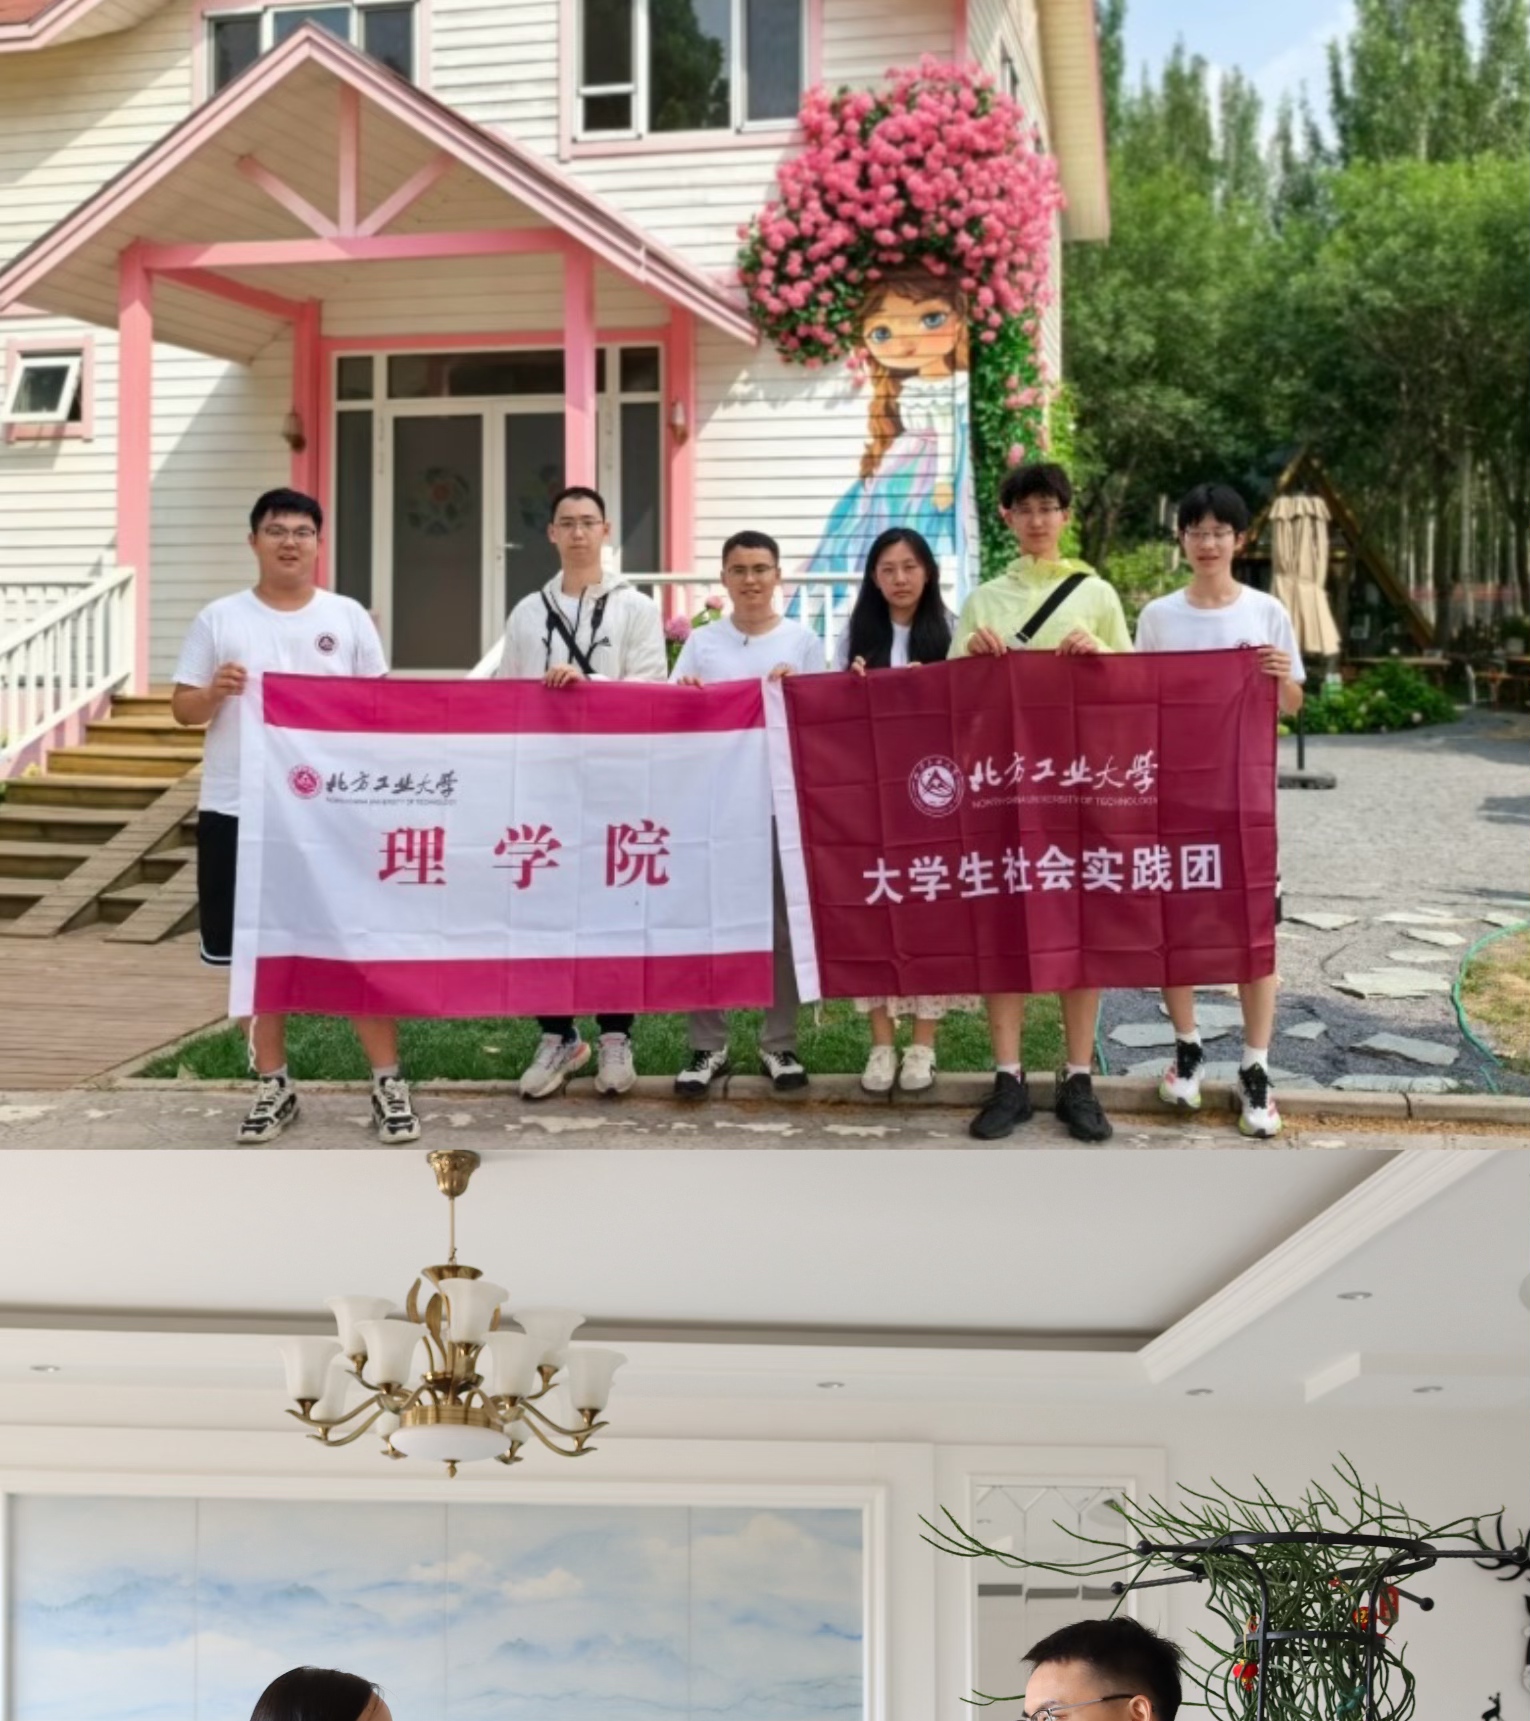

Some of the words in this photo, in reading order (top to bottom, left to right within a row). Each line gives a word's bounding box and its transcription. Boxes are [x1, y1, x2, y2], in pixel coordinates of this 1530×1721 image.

[325, 769, 458, 798] 北方工业大学
[969, 750, 1159, 793] 北方工业大学
[377, 819, 671, 890] 理学院
[862, 843, 1222, 905] 大学生社会实践团
